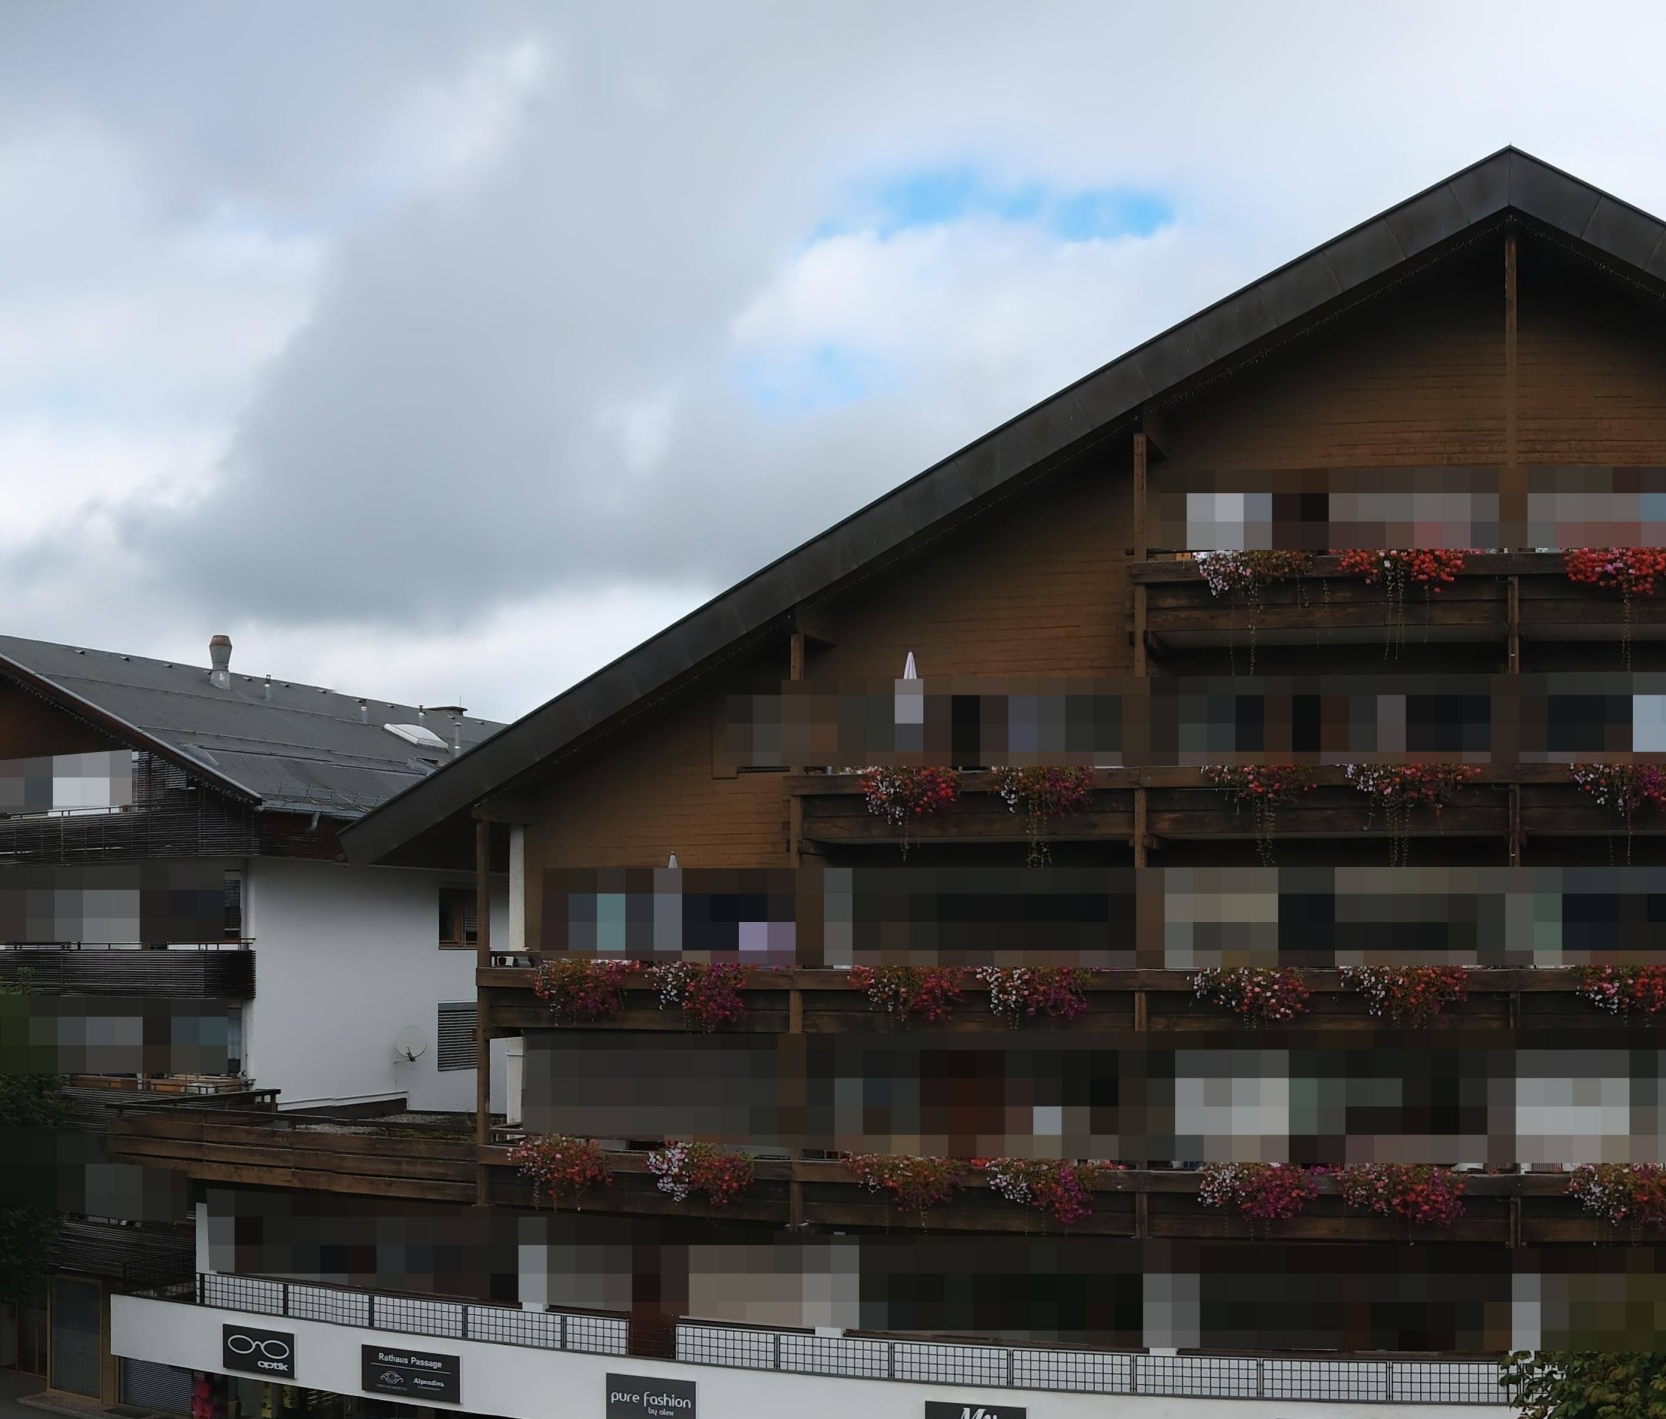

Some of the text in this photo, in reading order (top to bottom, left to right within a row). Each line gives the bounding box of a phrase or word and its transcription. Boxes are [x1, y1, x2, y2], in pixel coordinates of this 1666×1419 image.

[257, 1360, 288, 1372] optik
[378, 1352, 442, 1369] Rathaus Passage
[611, 1391, 691, 1408] pure fashion
[648, 1407, 658, 1416] by
